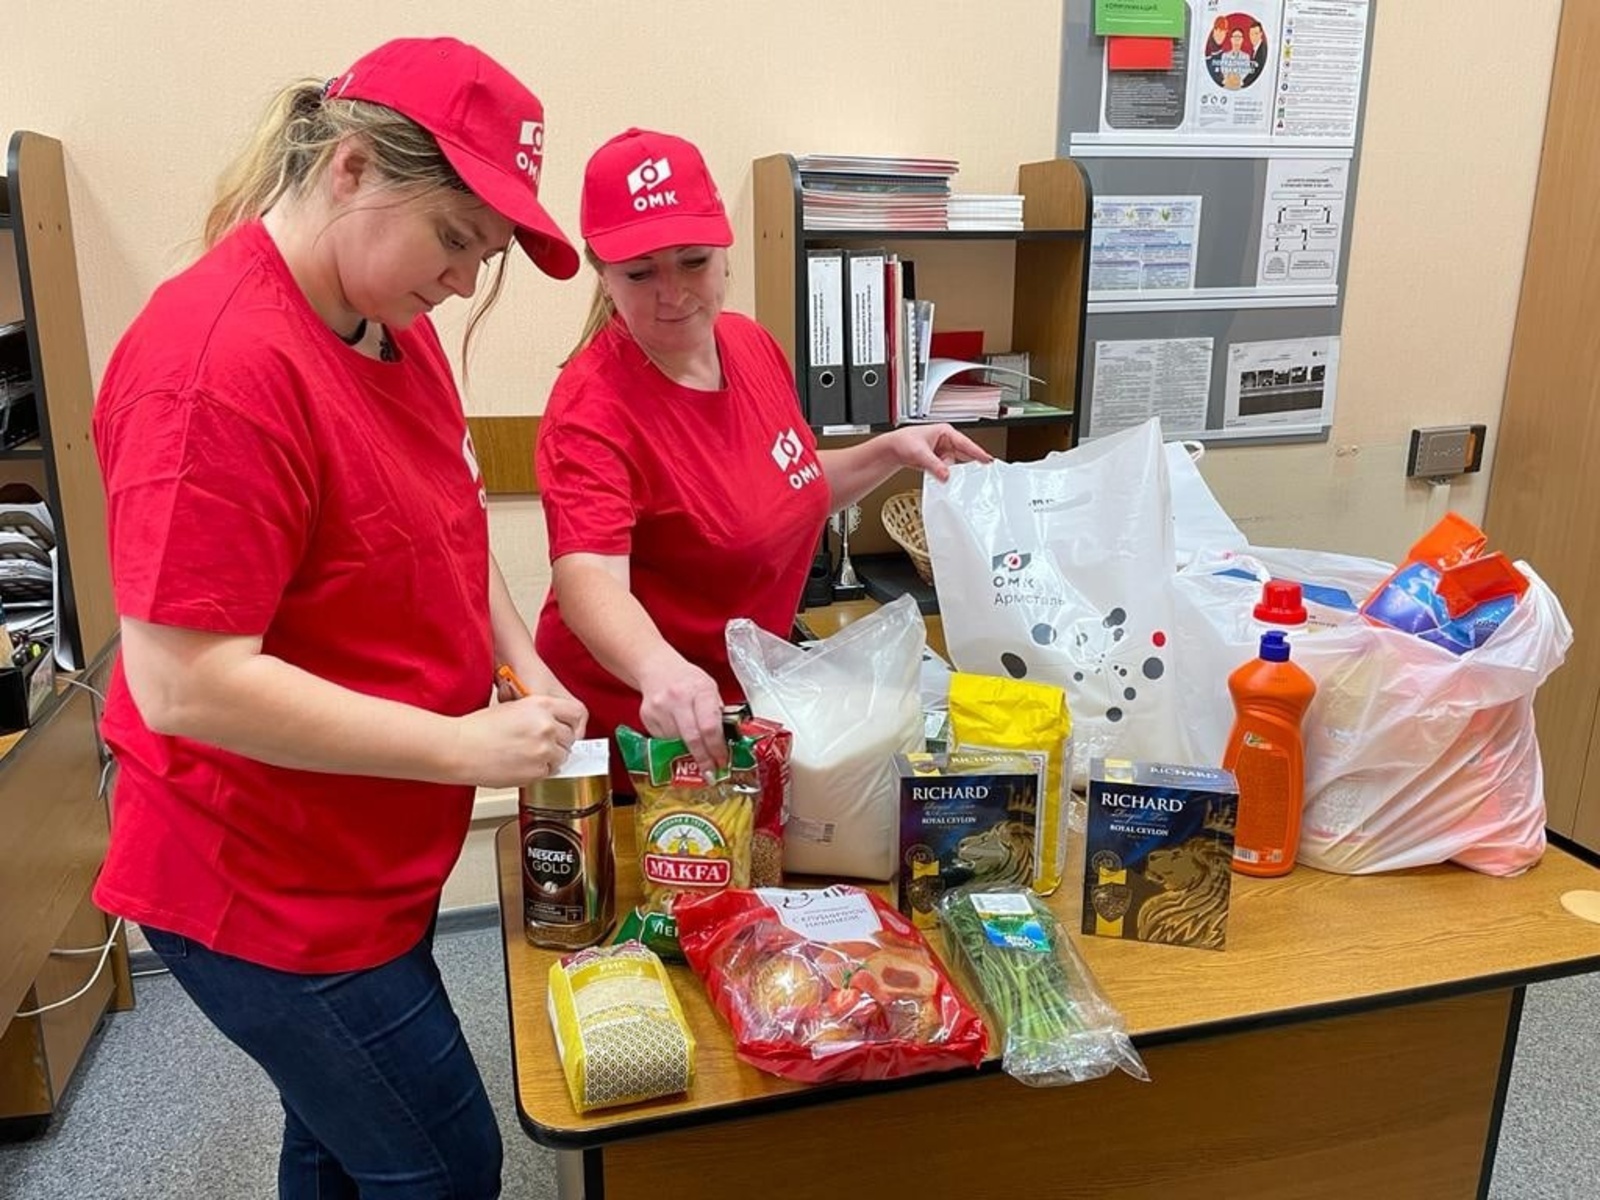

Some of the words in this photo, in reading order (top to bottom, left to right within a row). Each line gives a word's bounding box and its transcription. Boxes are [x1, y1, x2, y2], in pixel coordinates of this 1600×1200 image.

[632, 191, 679, 212] ОМК
[789, 461, 822, 490] ОМК
[993, 575, 1035, 588] ОМК
[993, 592, 1066, 607] Армсталь
[912, 785, 989, 801] RICHARD
[1101, 791, 1184, 813] RICHARD
[921, 817, 945, 825] ROYAL
[946, 816, 976, 824] CEYLON
[1109, 824, 1135, 834] ROYAL
[1136, 827, 1169, 837] CEYLON
[532, 860, 571, 875] GOLD
